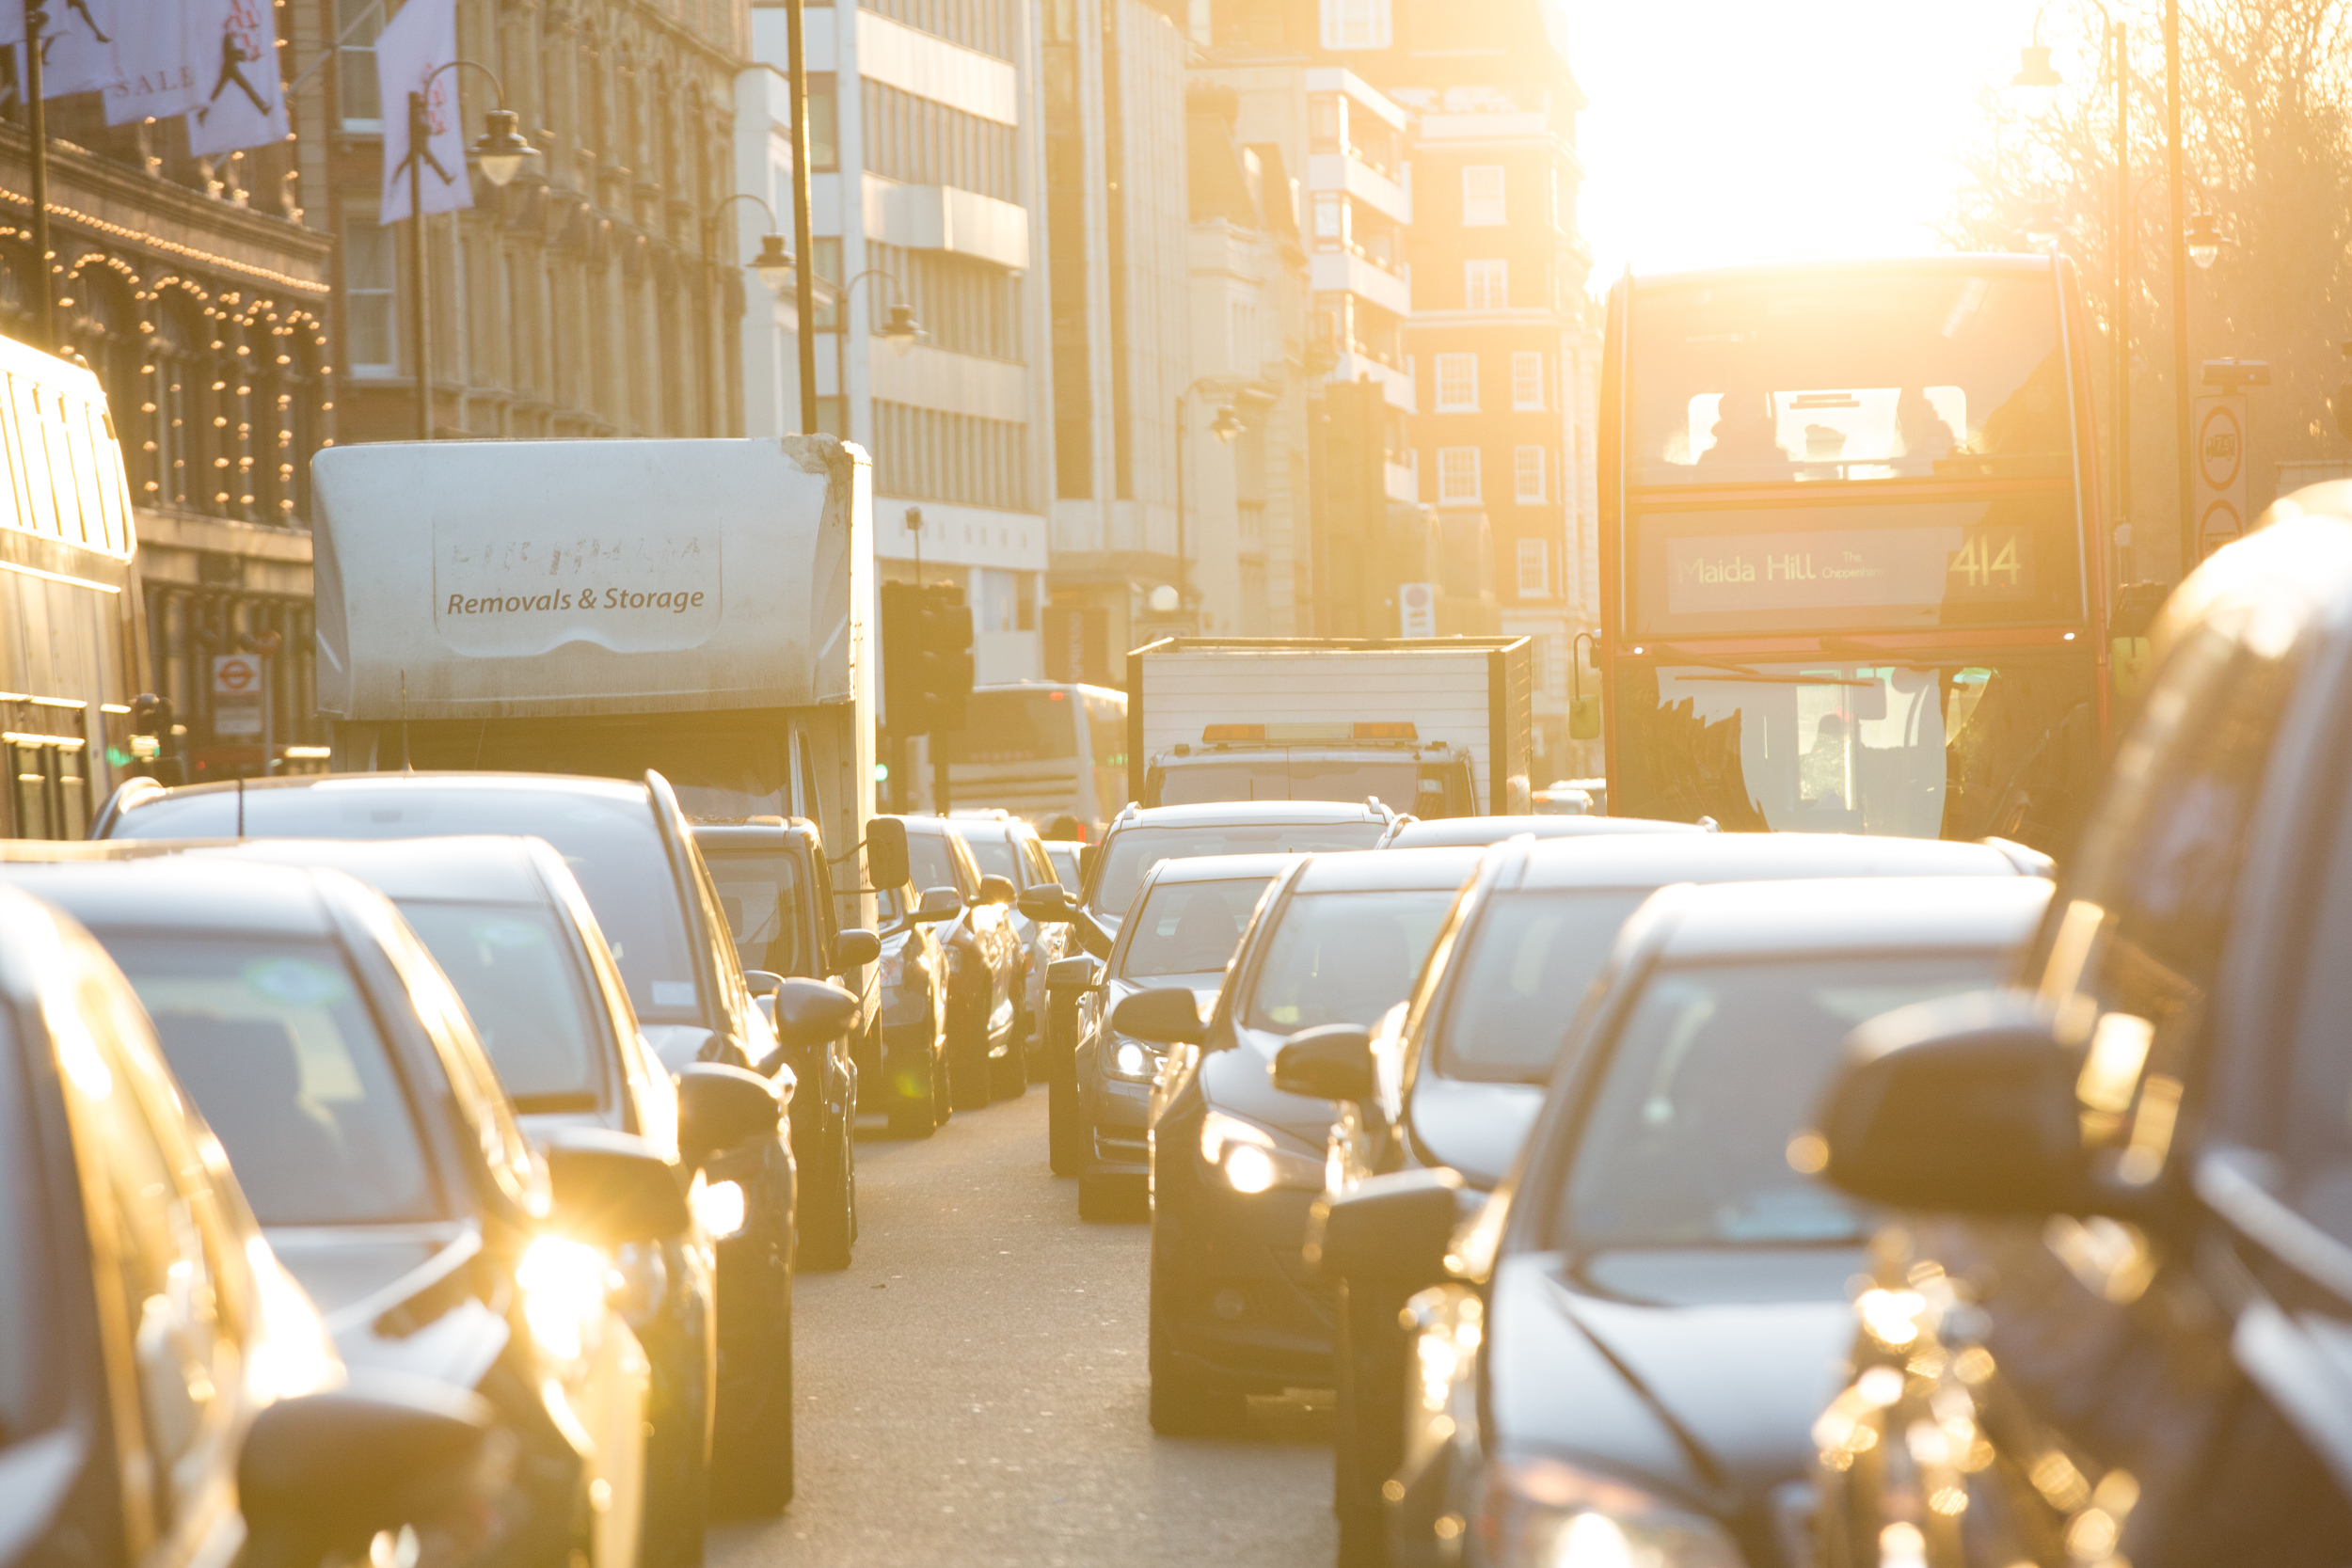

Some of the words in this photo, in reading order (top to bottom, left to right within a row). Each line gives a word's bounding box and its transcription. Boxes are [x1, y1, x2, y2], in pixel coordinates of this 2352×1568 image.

[114, 66, 194, 98] SALE
[1677, 555, 1756, 584] Maida
[1767, 553, 1817, 580] Hill
[1842, 550, 1863, 562] The
[1949, 534, 2021, 586] 414
[447, 588, 571, 615] Removals
[578, 587, 597, 610] &
[604, 587, 705, 613] Storage
